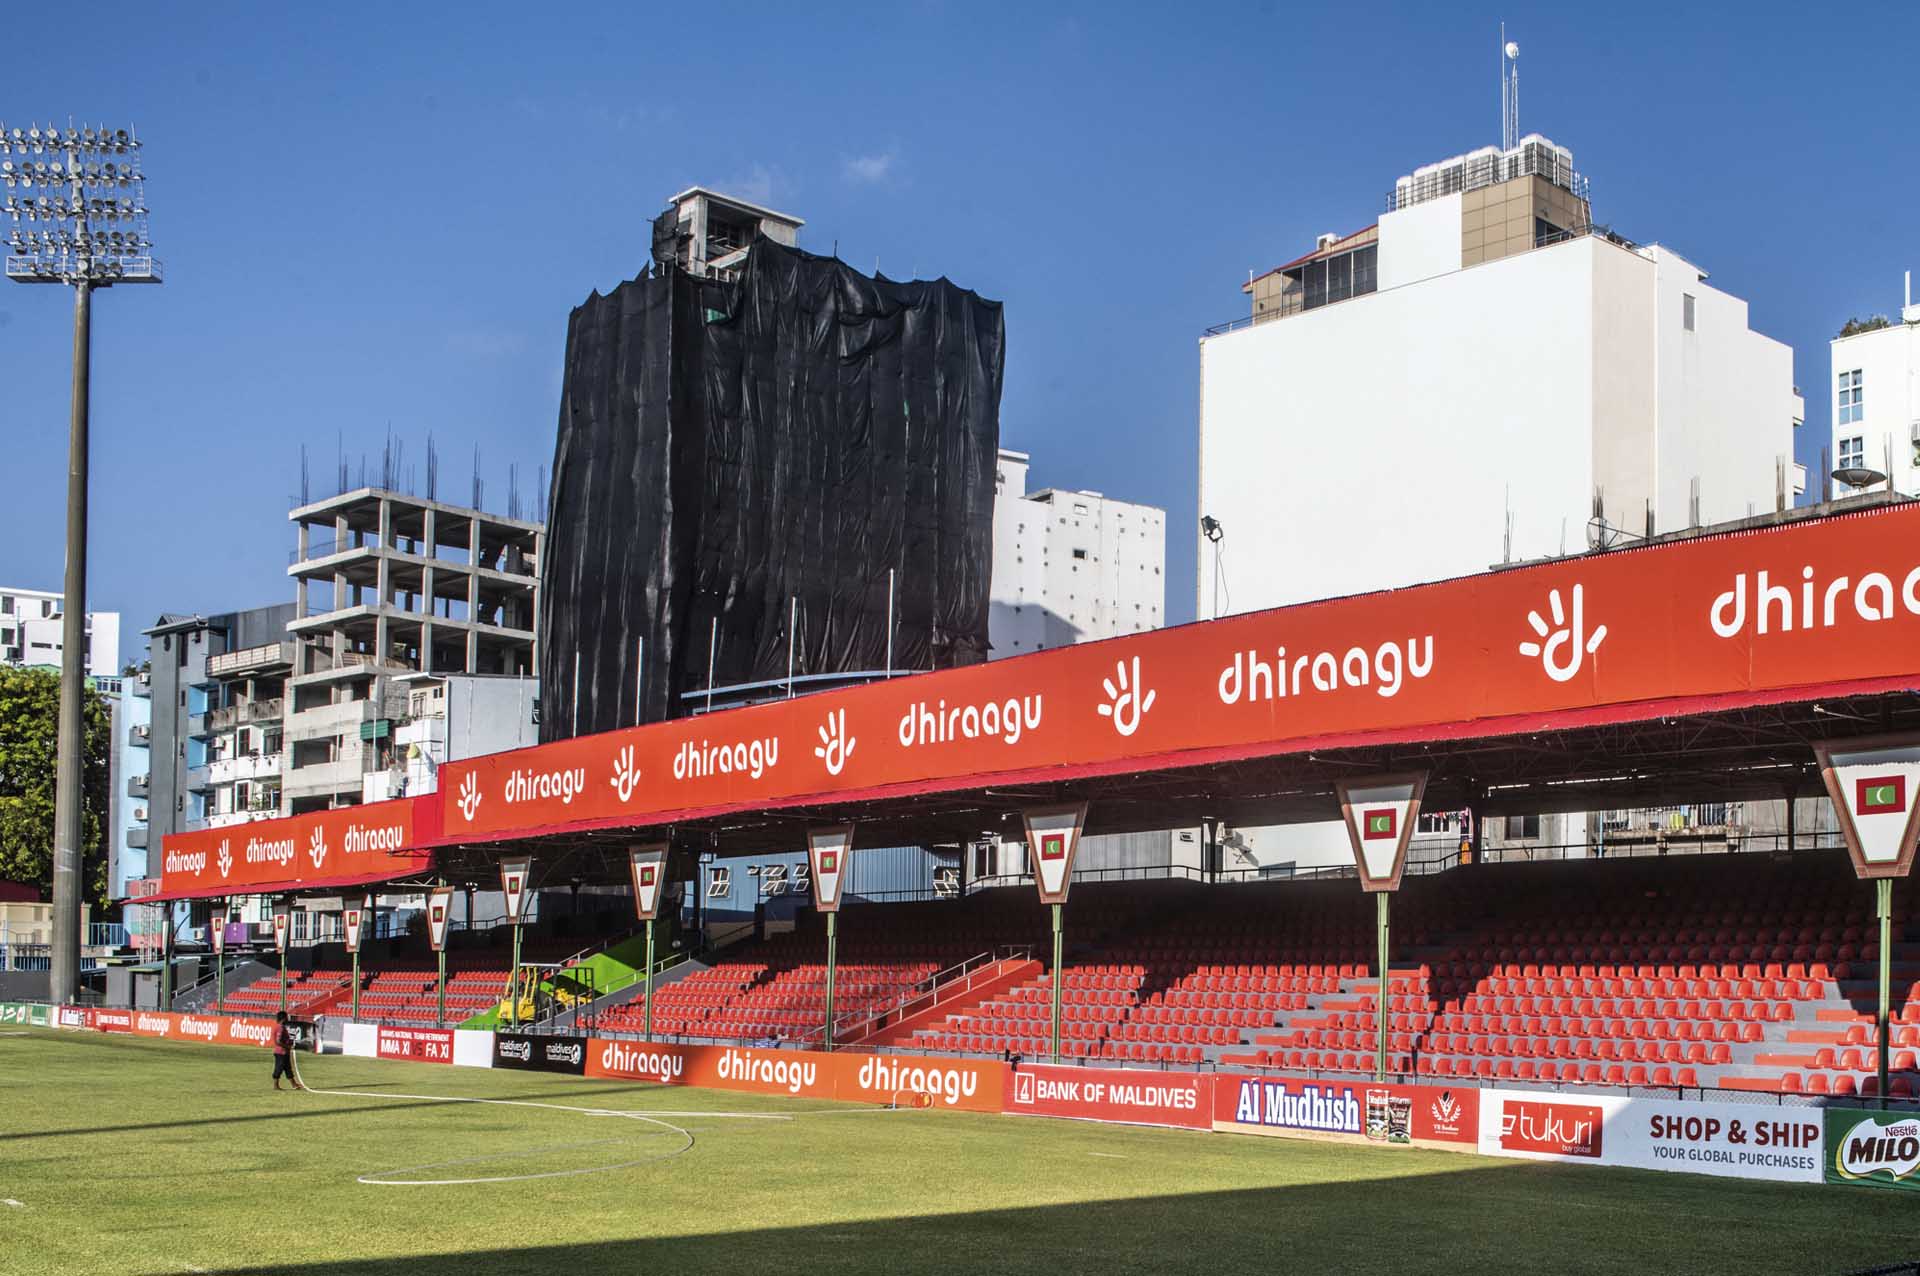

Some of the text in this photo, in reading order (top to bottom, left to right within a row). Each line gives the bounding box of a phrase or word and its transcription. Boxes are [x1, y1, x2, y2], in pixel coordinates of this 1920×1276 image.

[1218, 636, 1433, 698] dhiraagu
[899, 695, 1042, 746] dhiraagu
[673, 737, 779, 779] dhiraagu
[505, 768, 585, 804] dhiraagu
[246, 838, 294, 866] dhiraagu
[345, 825, 403, 852] dhiraagu
[166, 850, 206, 876] dhiraagu
[137, 1012, 170, 1036] dhiraagu
[180, 1015, 218, 1041] dhiraagu
[230, 1018, 272, 1046] dhiraagu
[381, 1039, 400, 1054] MMA
[402, 1041, 410, 1055] XI
[425, 1043, 438, 1057] FA
[440, 1044, 449, 1058] XI
[546, 1043, 572, 1054] maldives
[602, 1041, 684, 1082] dhiraagu
[717, 1049, 816, 1093] dhiraagu
[858, 1057, 977, 1105] dhiraagu
[1037, 1080, 1197, 1110] BANK OF MALDIVES
[1236, 1081, 1260, 1123] Al
[1264, 1083, 1360, 1134] Mudhish
[1650, 1114, 1819, 1149] SHOP & SHIP
[1653, 1146, 1815, 1170] YOUR GLOBAL PURCHASES
[1848, 1137, 1920, 1164] MILO
